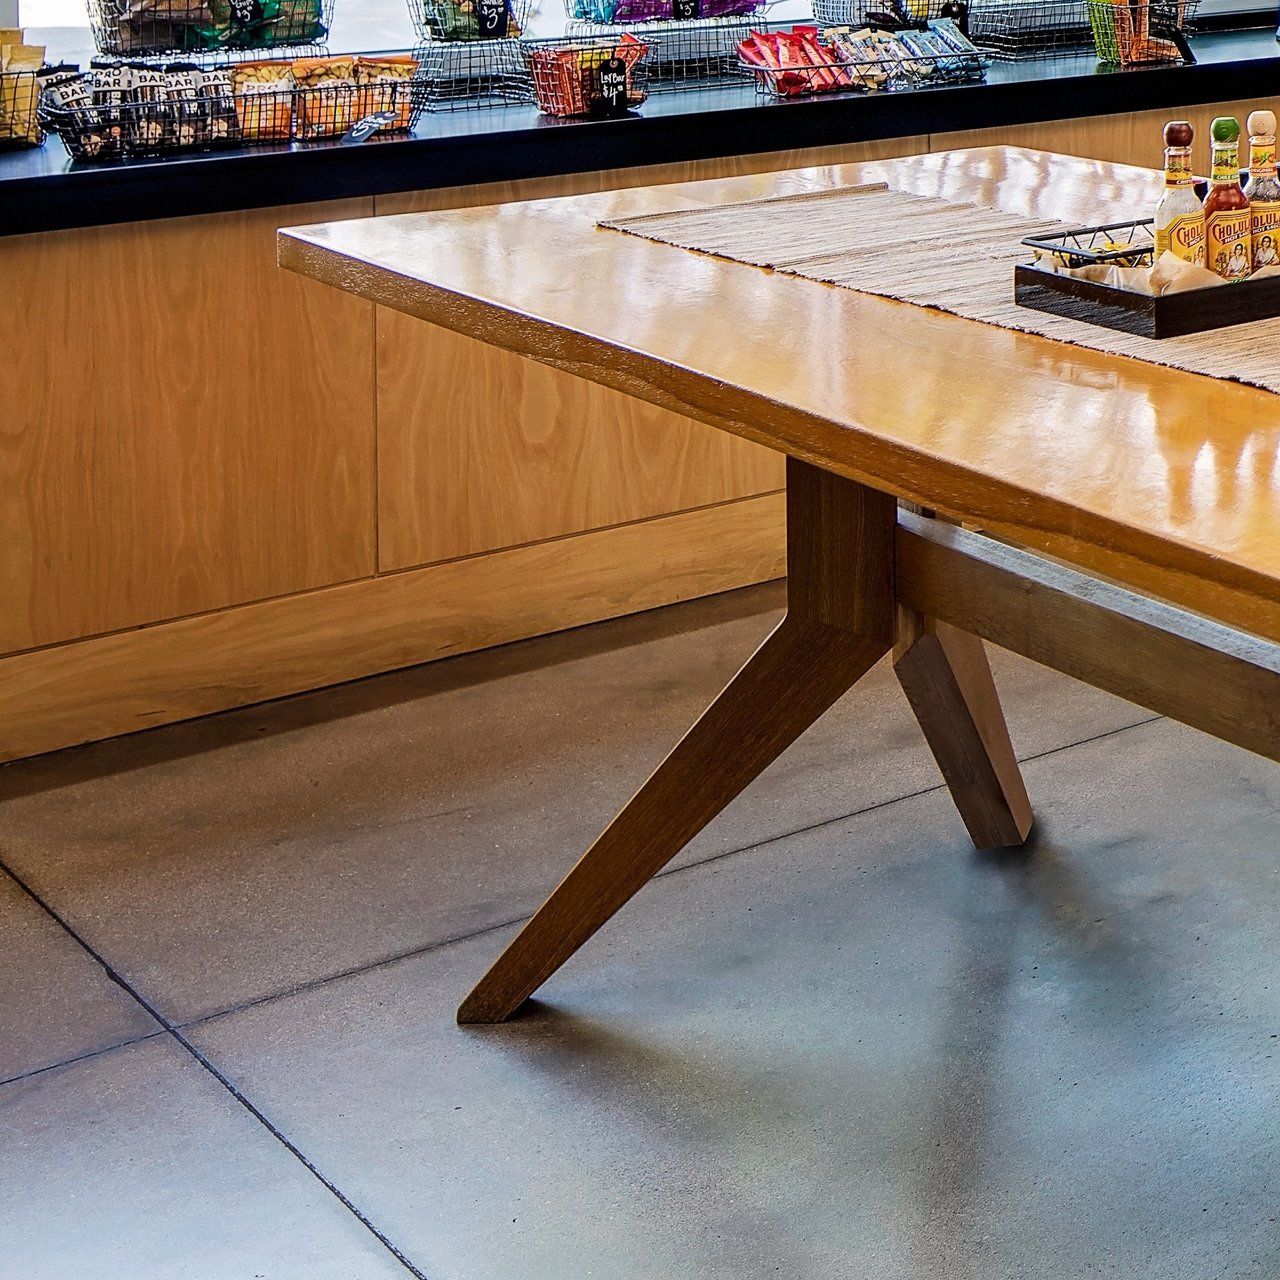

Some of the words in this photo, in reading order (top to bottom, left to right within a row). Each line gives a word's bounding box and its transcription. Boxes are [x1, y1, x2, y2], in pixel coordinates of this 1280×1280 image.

[139, 74, 166, 83] BAR
[166, 77, 193, 87] BAR
[203, 73, 230, 83] BAR
[94, 79, 121, 88] BAR
[60, 86, 87, 101] BAR
